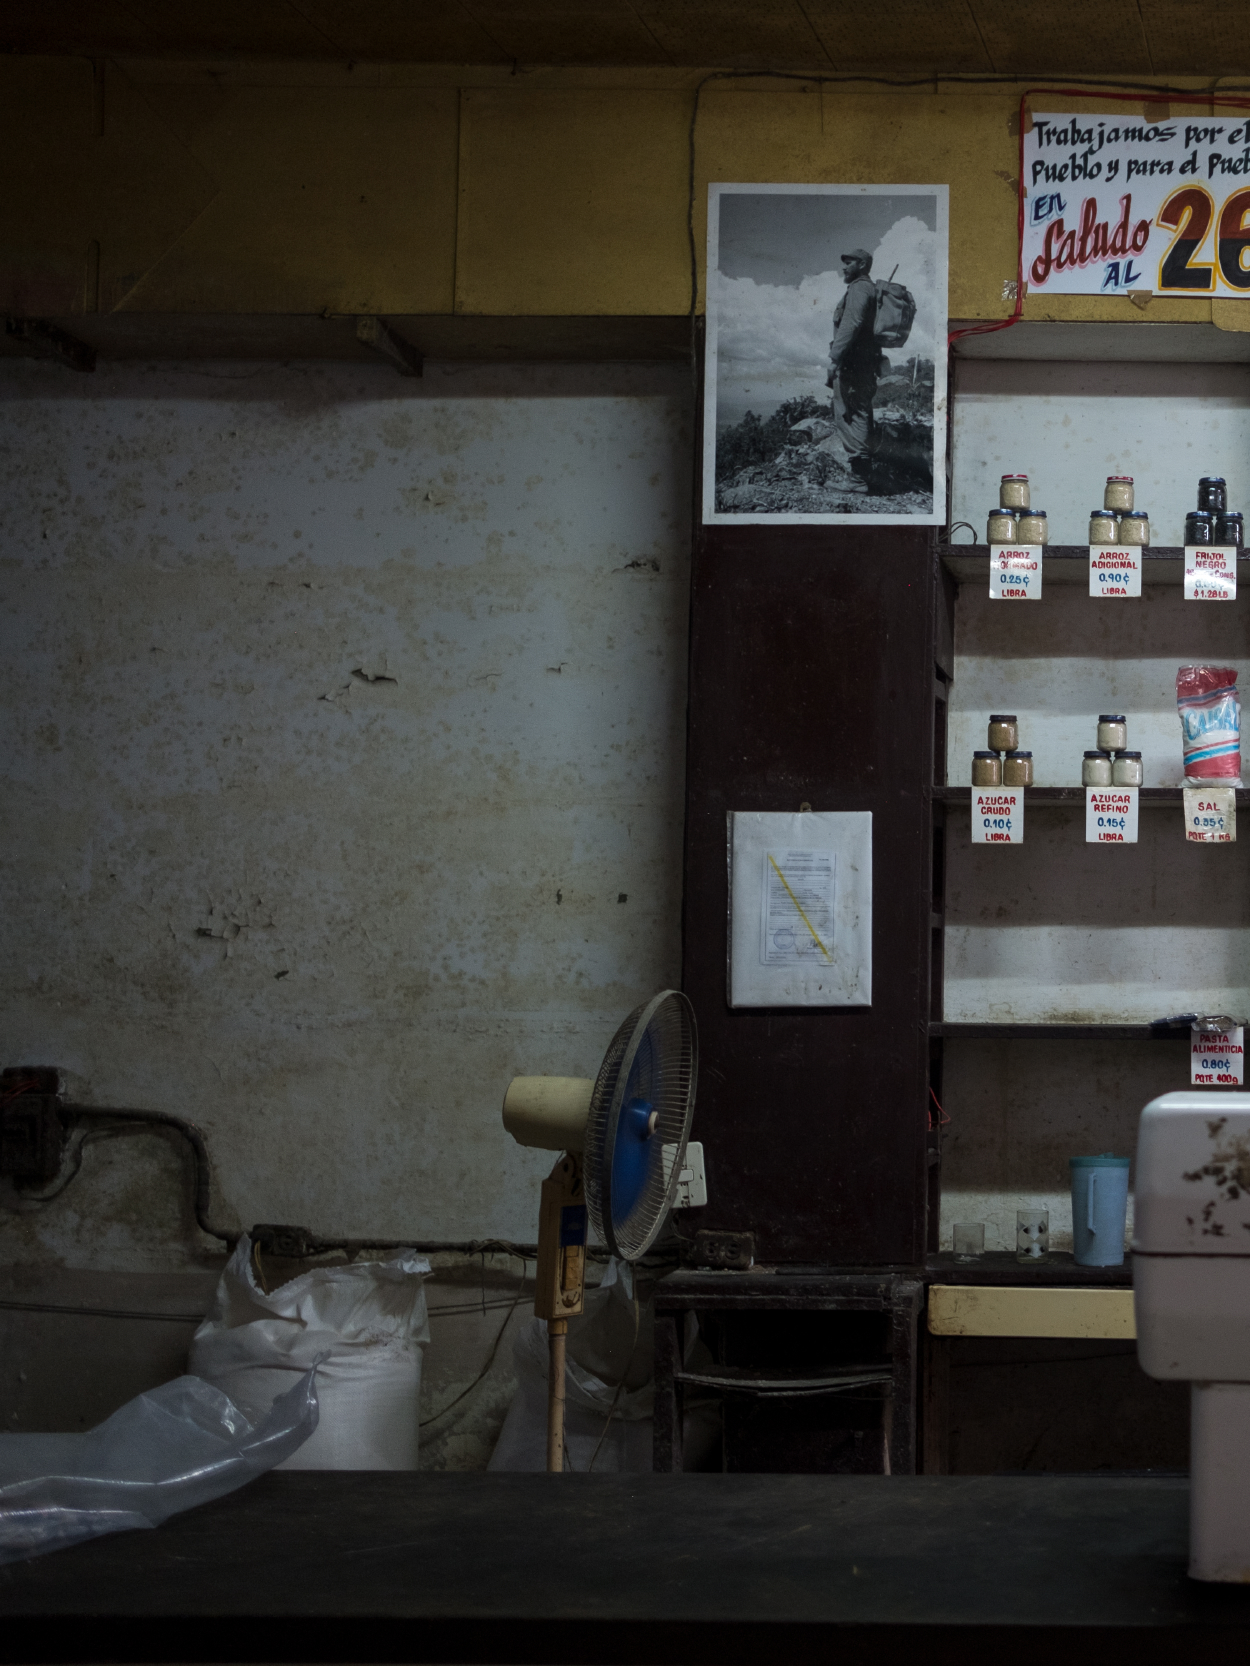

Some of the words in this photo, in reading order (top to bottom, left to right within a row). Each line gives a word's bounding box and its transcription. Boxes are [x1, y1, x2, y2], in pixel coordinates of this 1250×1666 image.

[1032, 118, 1178, 155] Trabajamos
[1184, 125, 1225, 149] por
[1032, 152, 1102, 187] Pueblo
[1104, 159, 1120, 182] y
[1126, 159, 1175, 183] para
[1179, 150, 1200, 175] el
[1031, 193, 1154, 284] Saludo
[1102, 260, 1142, 288] AL
[999, 550, 1030, 560] ARROZ
[1099, 552, 1131, 561] ARROZ
[1196, 551, 1227, 561] FRIJOL
[1091, 560, 1139, 569] ADICIONAL
[1195, 560, 1227, 570] NEGRO
[1098, 572, 1130, 586] 0.90¢
[1001, 589, 1027, 598] LIBRA
[1101, 587, 1127, 595] LIBRA
[977, 796, 1017, 805] AZUCAR
[1091, 794, 1131, 803] AZUCAR
[980, 806, 1011, 815] CRUDO
[1093, 803, 1129, 814] REFINO
[1197, 801, 1221, 811] SAL
[983, 818, 1013, 831] 0.10¢
[1097, 816, 1126, 830] 0.15¢
[985, 832, 1012, 841] LIBRA
[1098, 832, 1124, 841] LIBRA
[1199, 1034, 1230, 1043] PASTA
[1192, 1044, 1243, 1054] ALIMENTICIA
[1201, 1058, 1231, 1072] 0.80¢
